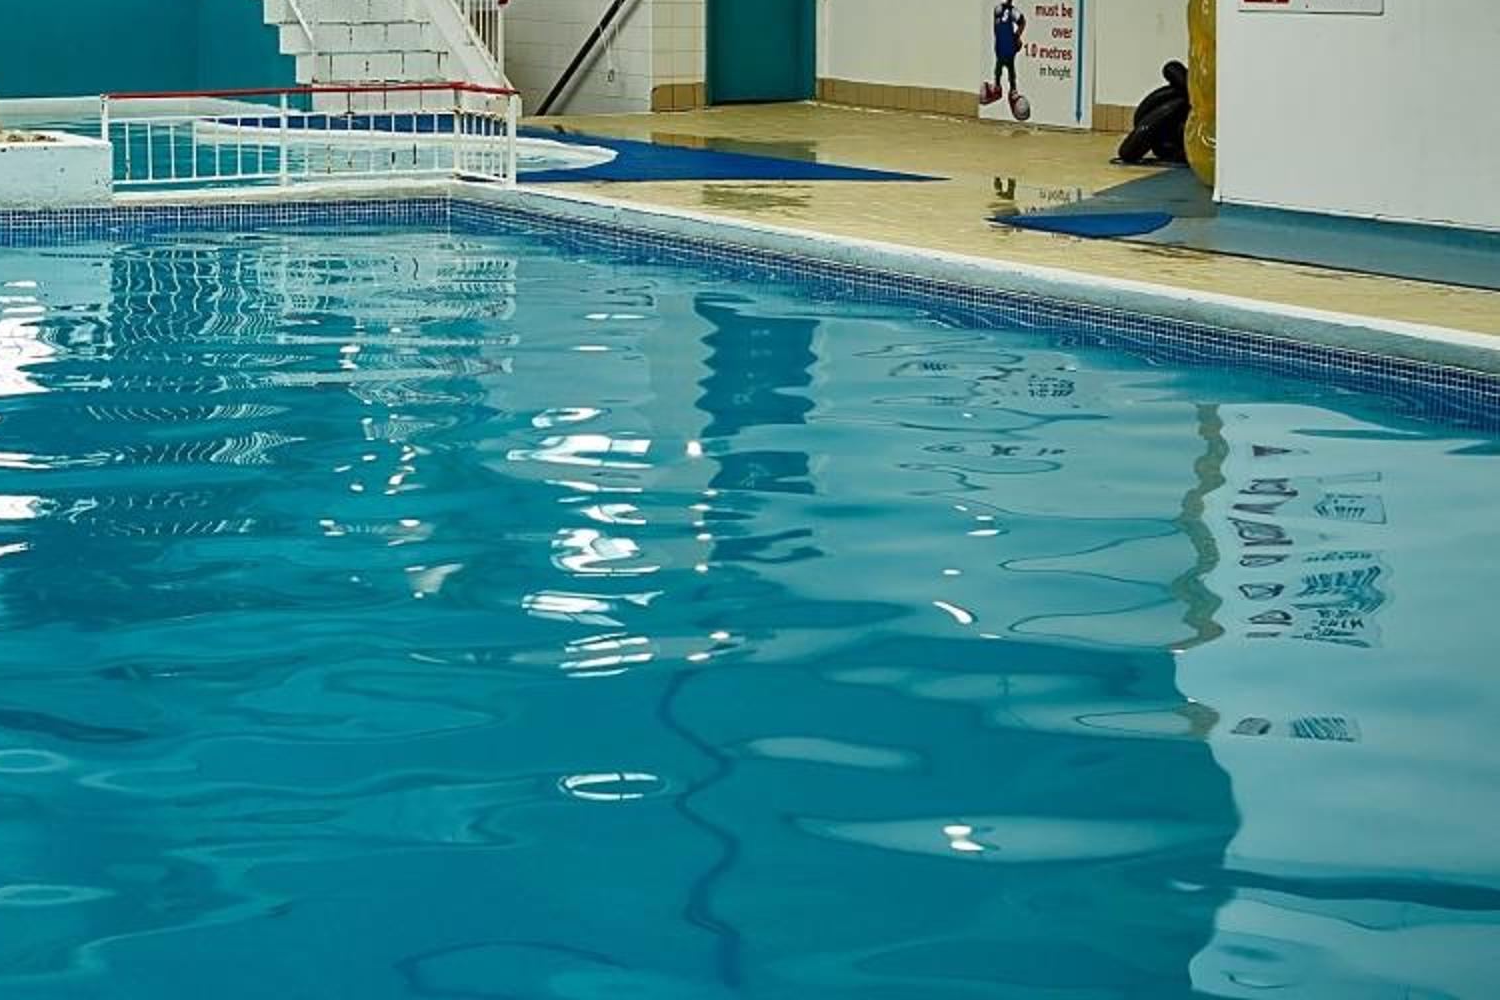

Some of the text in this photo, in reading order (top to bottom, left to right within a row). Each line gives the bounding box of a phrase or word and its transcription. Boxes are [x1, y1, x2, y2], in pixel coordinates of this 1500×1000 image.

[1035, 3, 1073, 18] must be
[1051, 27, 1073, 39] over
[1039, 47, 1073, 61] metres
[1047, 65, 1071, 81] height
